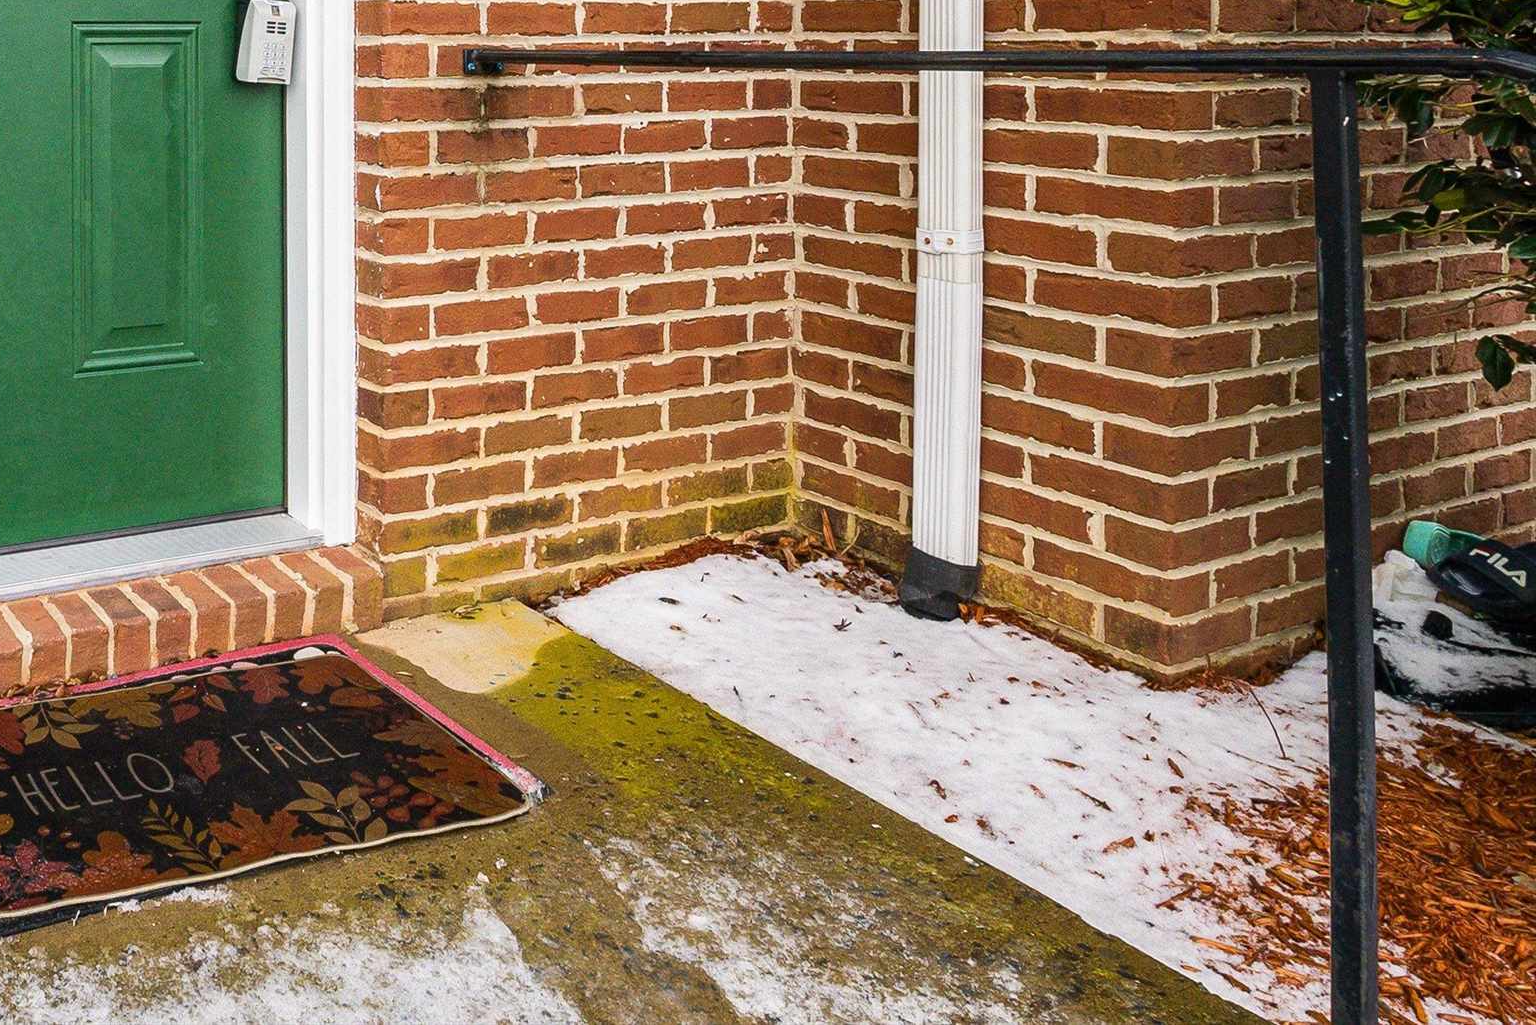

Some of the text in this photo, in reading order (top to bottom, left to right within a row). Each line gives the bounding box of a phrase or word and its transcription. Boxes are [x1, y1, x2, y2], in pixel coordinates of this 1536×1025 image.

[1469, 546, 1527, 587] FILA
[11, 722, 361, 815] HELLO FALL
